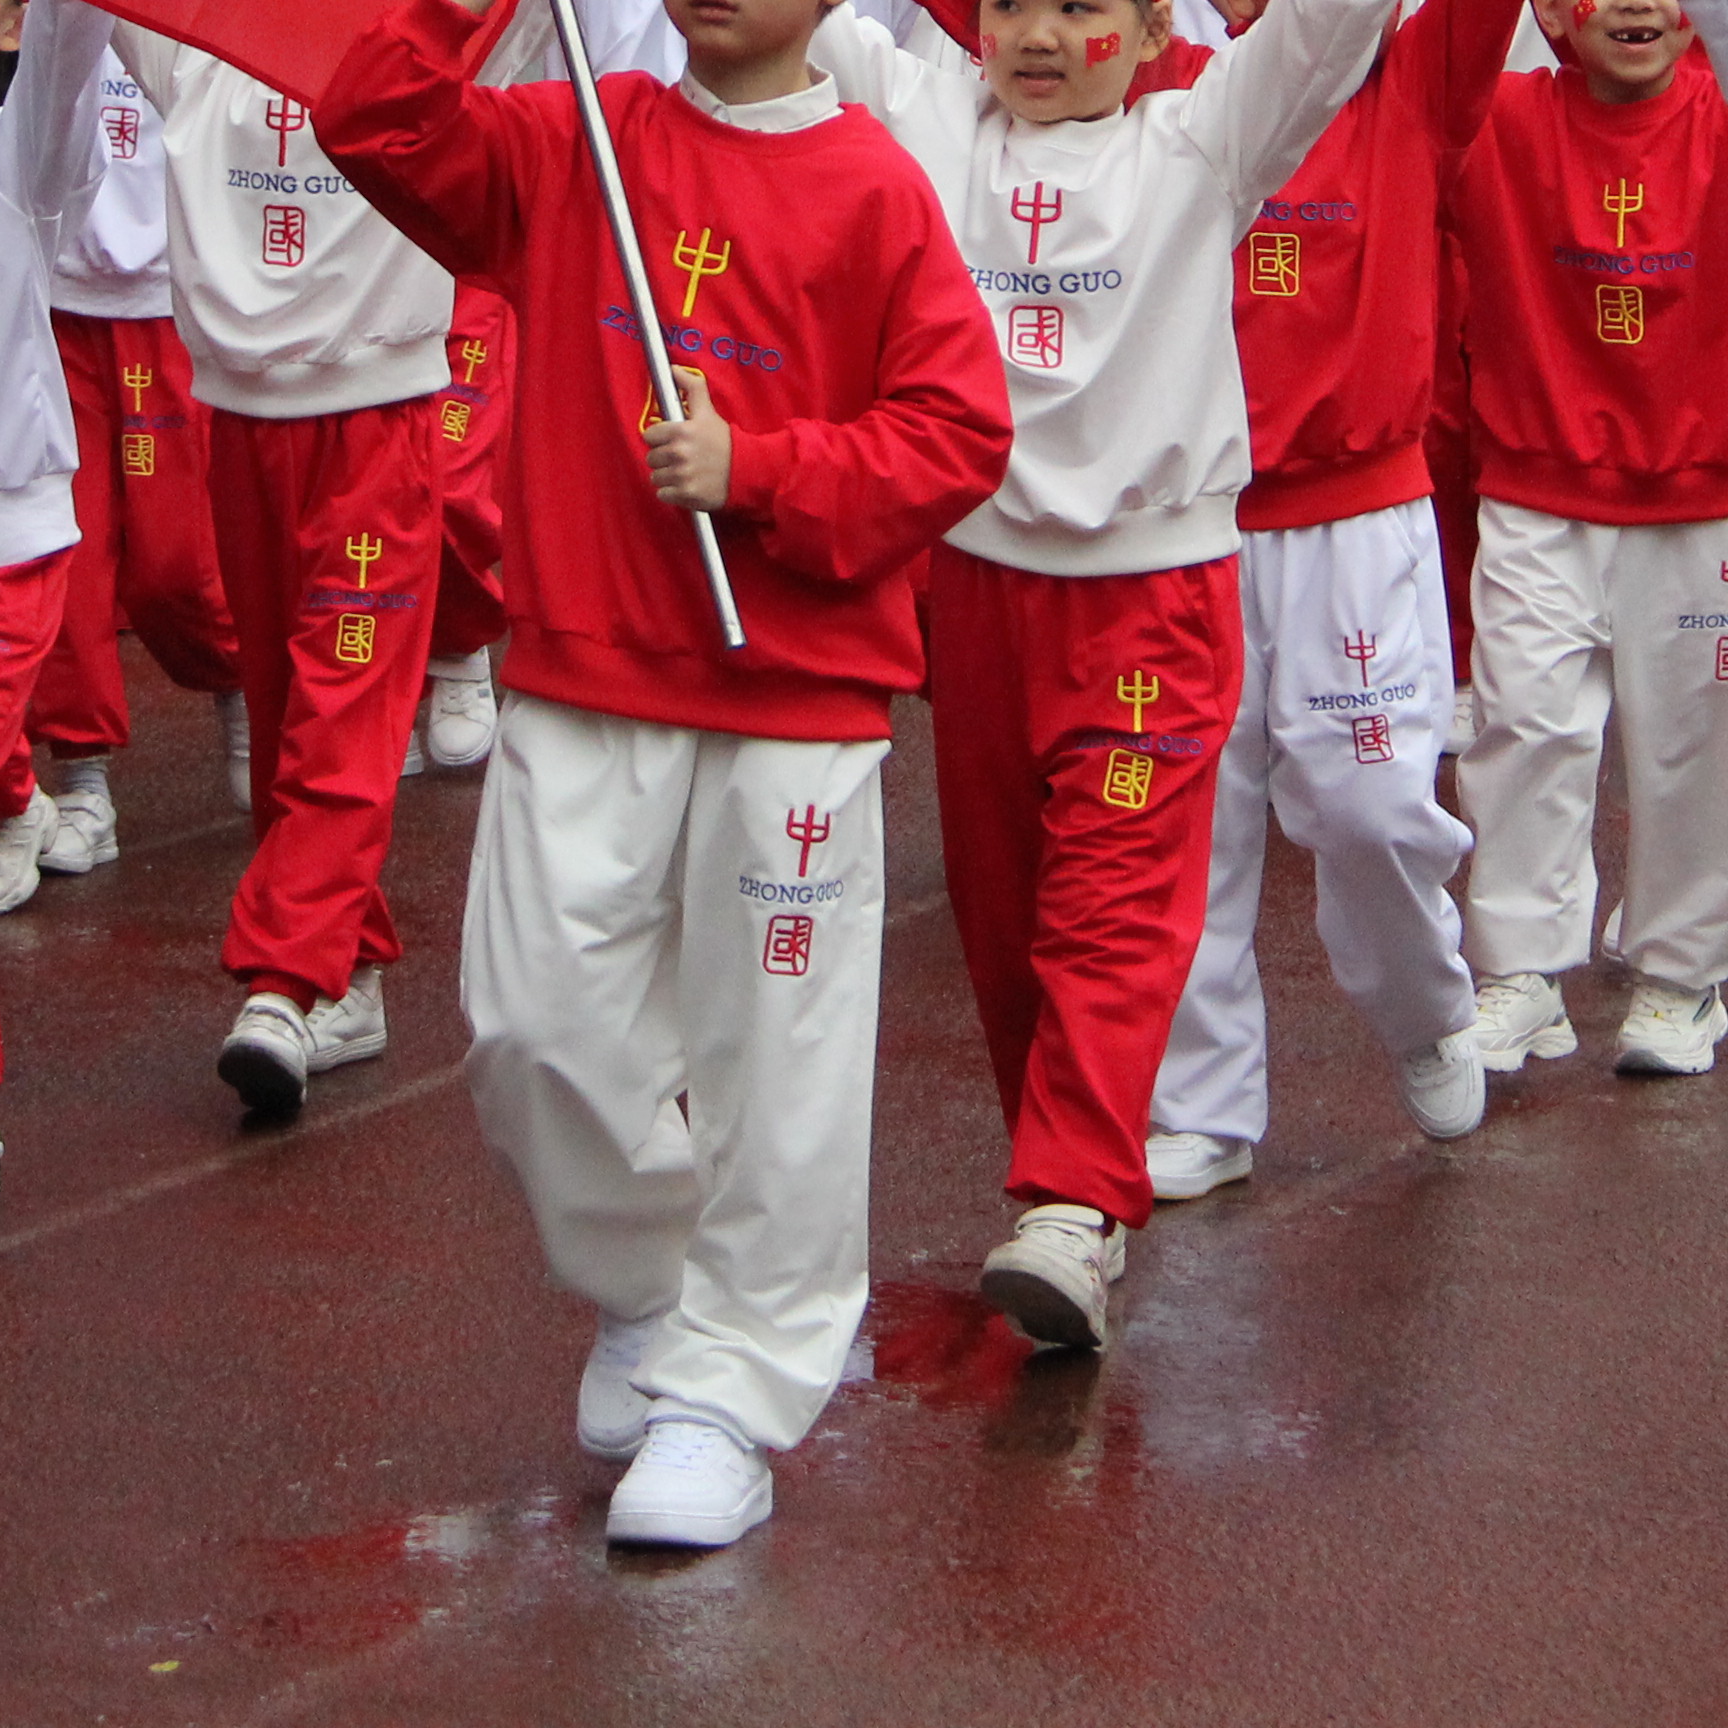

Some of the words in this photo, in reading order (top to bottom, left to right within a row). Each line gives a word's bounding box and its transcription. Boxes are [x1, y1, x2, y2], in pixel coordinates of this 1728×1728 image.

[228, 169, 297, 195] ZHONG
[1299, 200, 1357, 222] GUO
[1641, 250, 1695, 273] GUO
[1059, 268, 1122, 294] GUO
[599, 305, 704, 352] ZHNG
[711, 336, 783, 371] GUO
[1309, 689, 1379, 712] ZHONG
[1381, 683, 1416, 702] GUO
[1158, 736, 1203, 755] GUO
[739, 876, 813, 904] ZHONG
